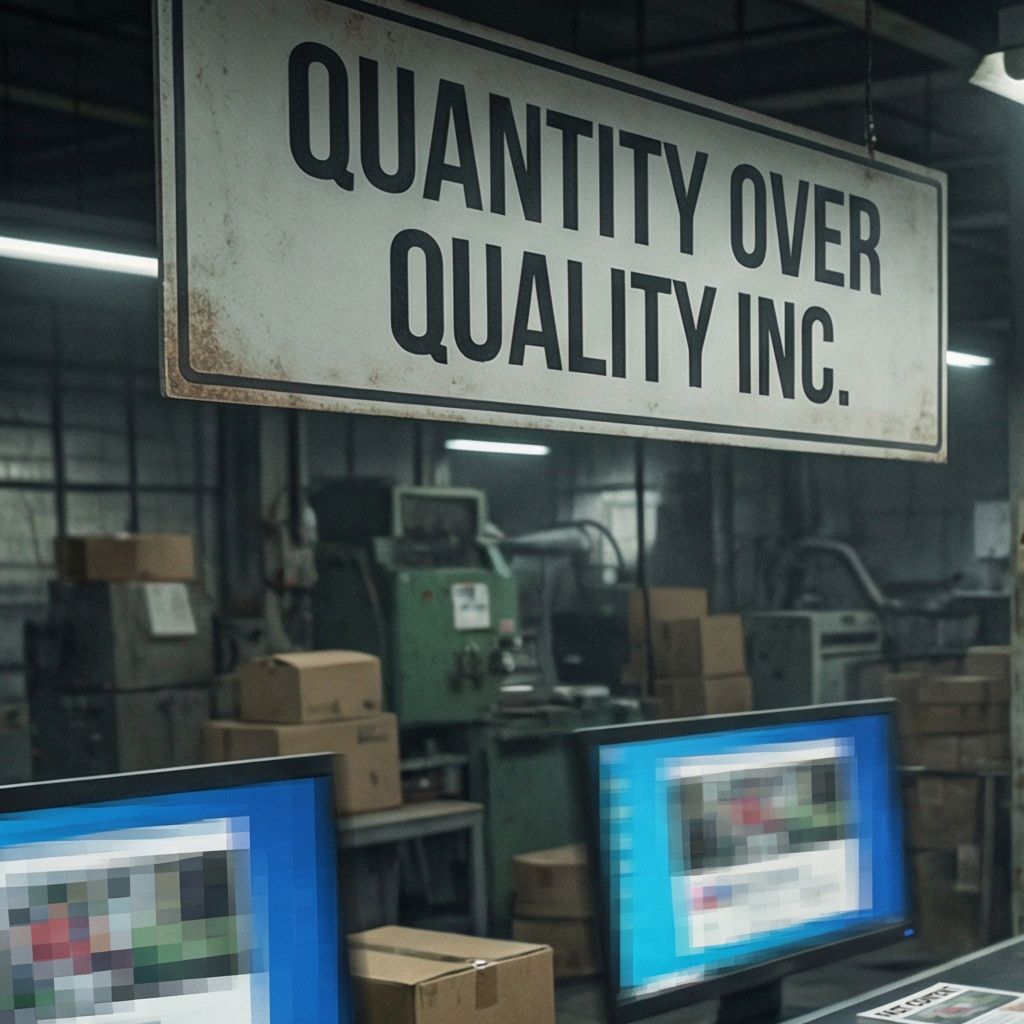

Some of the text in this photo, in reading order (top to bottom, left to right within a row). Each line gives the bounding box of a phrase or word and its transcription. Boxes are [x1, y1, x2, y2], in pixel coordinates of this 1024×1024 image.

[288, 42, 882, 295] QUANTITY OVER
[390, 228, 850, 406] QUALITY INC.
